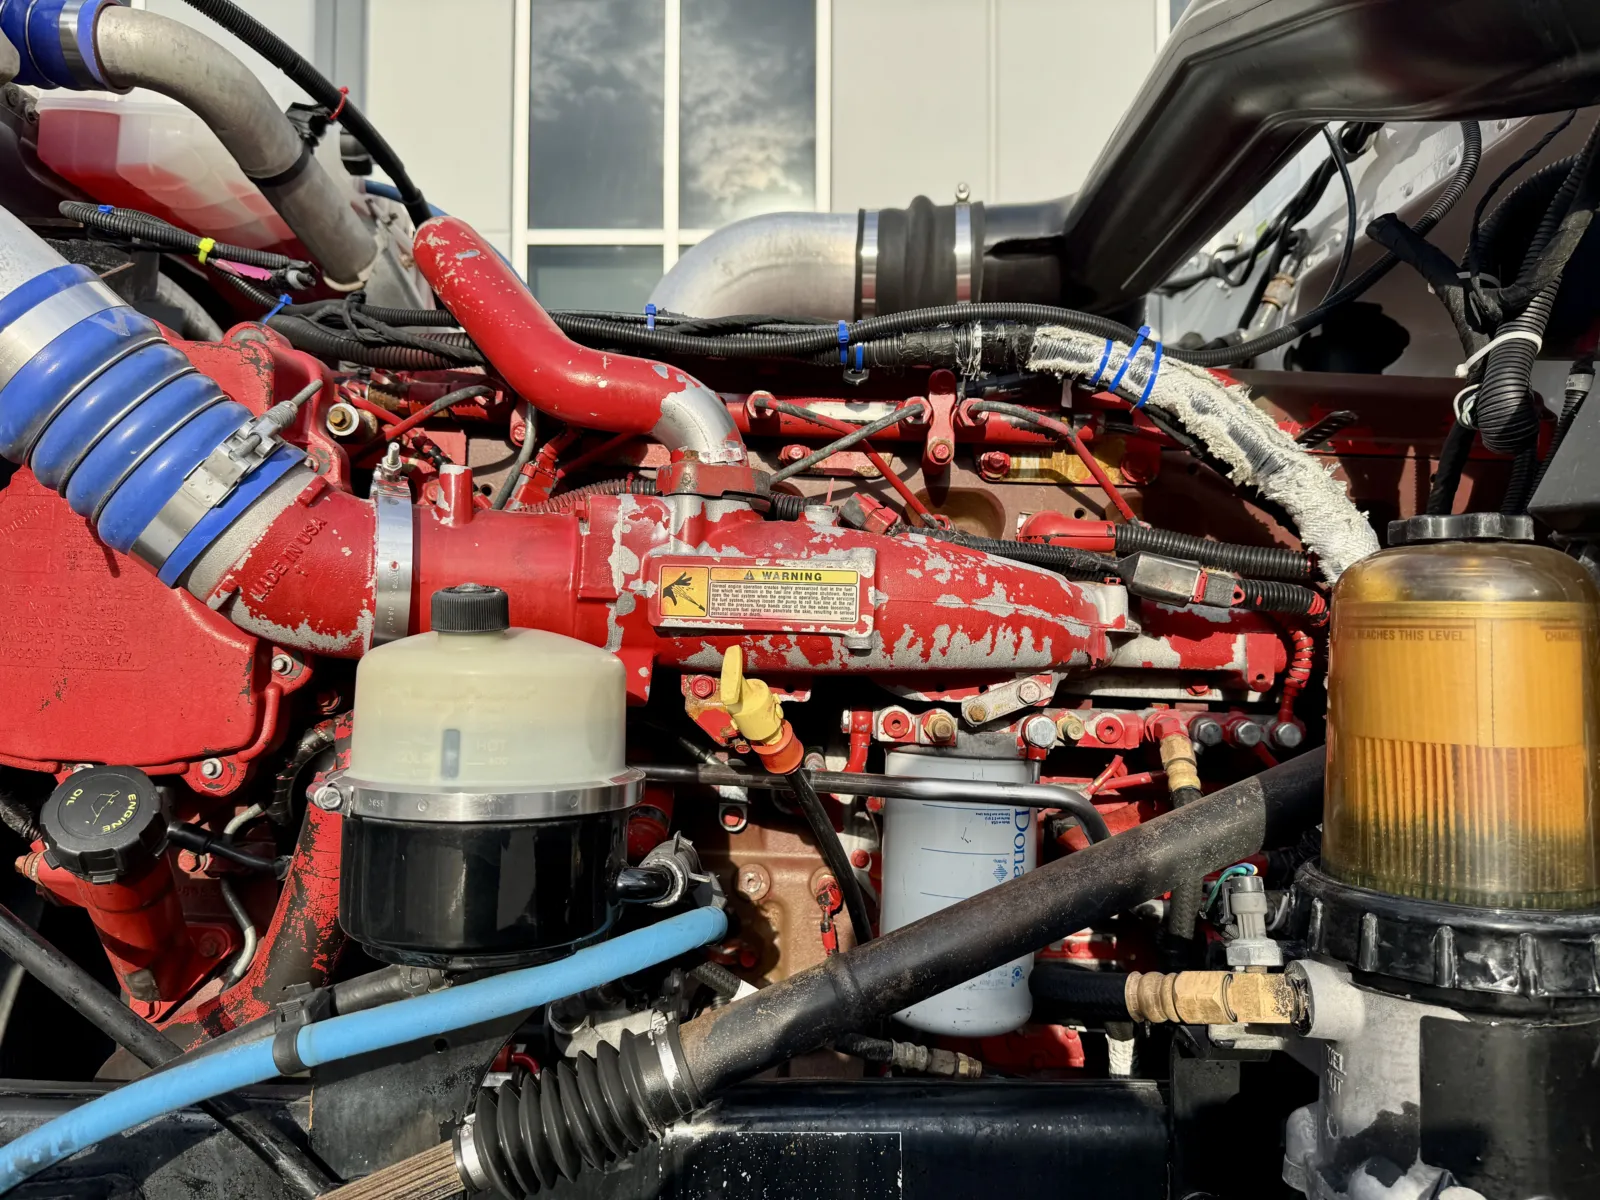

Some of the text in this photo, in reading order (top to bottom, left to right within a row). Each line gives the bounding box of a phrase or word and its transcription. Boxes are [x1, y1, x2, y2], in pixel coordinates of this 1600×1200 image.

[249, 517, 328, 602] MADE IN USA
[762, 571, 822, 581] WARNING
[1357, 629, 1396, 640] REACHES
[1398, 629, 1424, 641] THIS
[1428, 630, 1466, 642] LEVEL
[66, 788, 84, 806] OIL
[102, 793, 137, 832] ENGINE
